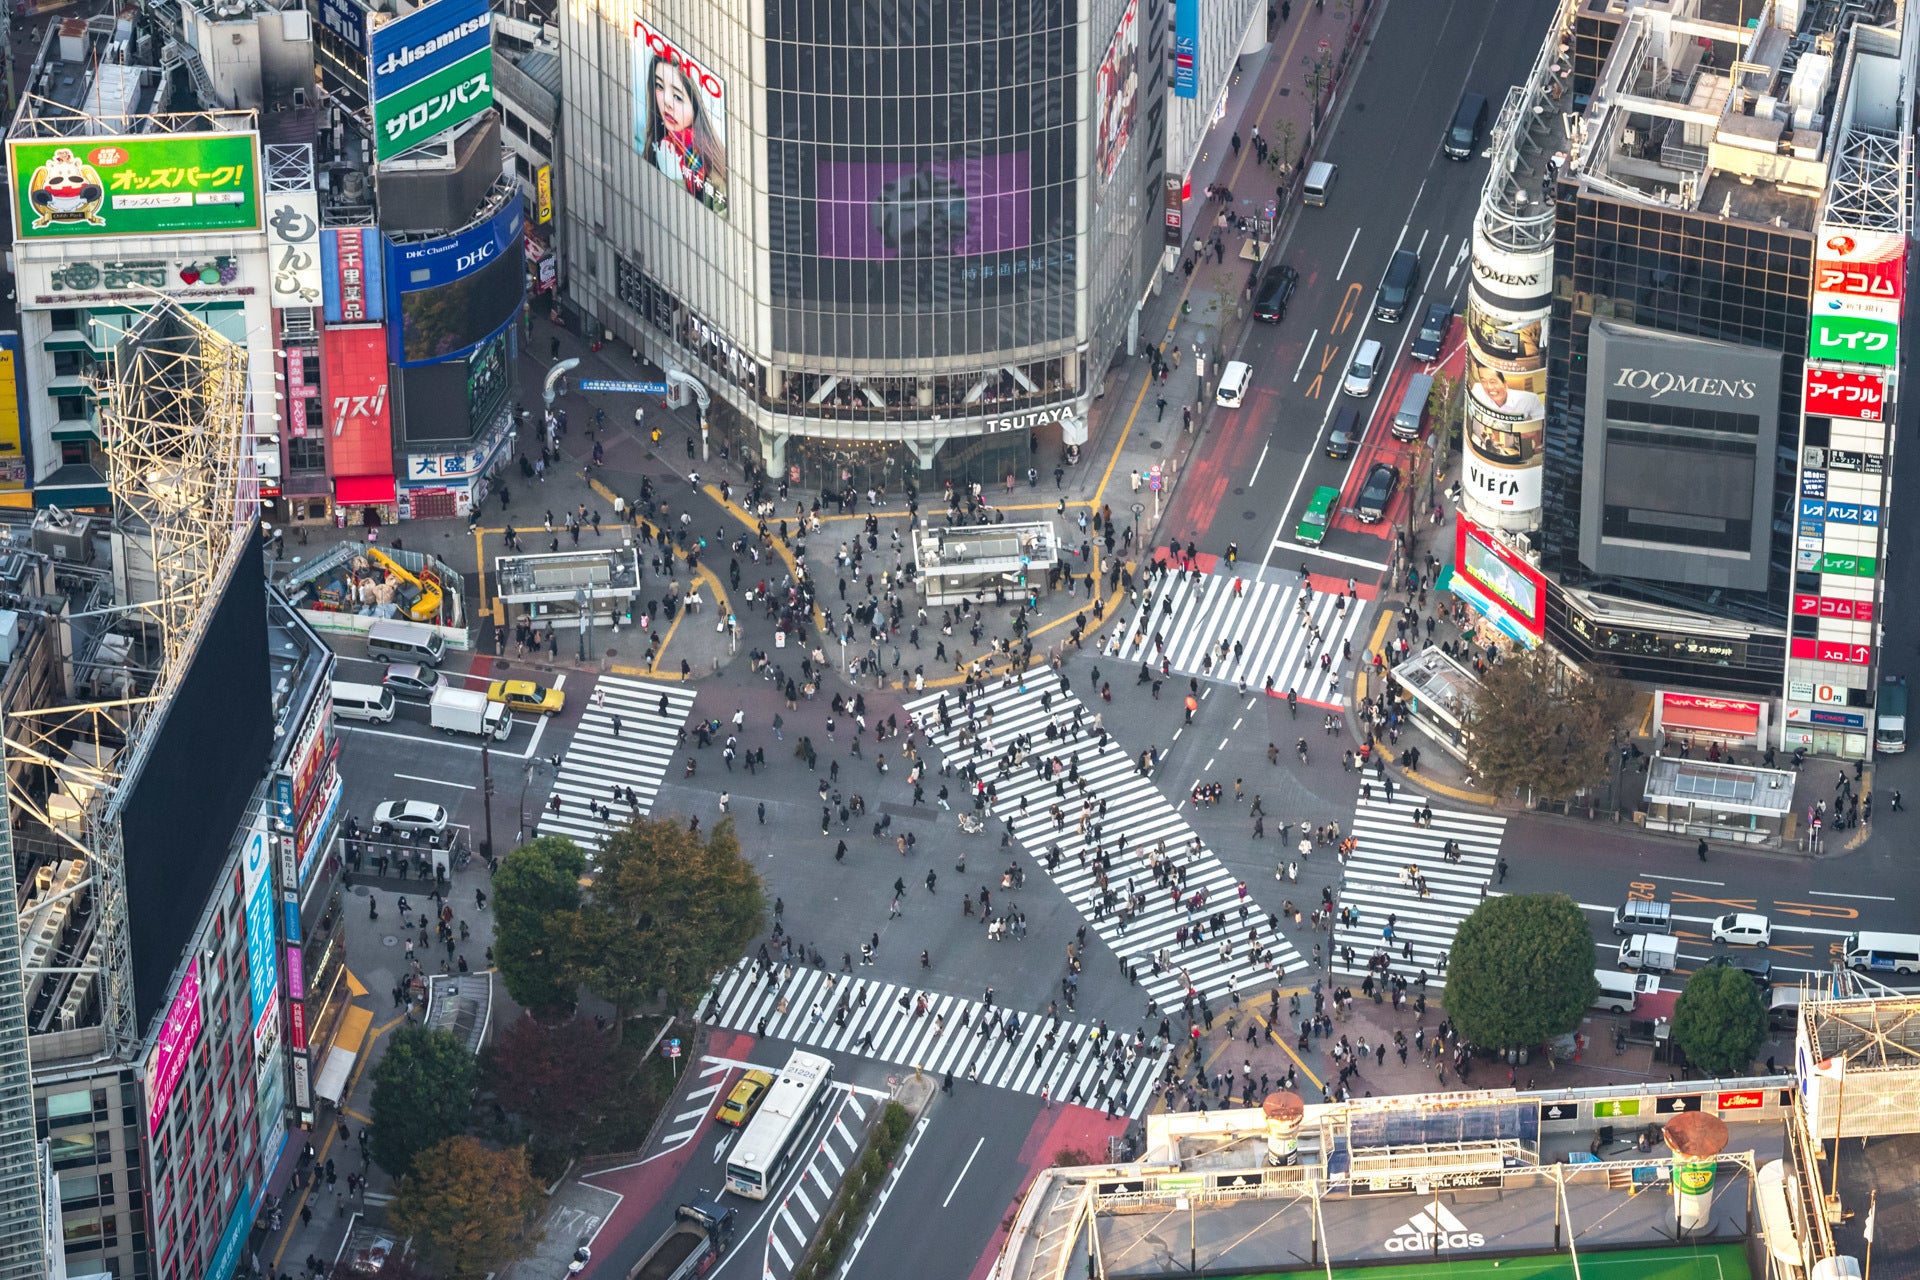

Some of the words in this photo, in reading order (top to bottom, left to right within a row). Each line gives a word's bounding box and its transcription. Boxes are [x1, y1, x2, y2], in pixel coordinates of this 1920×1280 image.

[330, 0, 358, 21] 服の
[323, 3, 360, 47] 青山
[376, 11, 490, 75] Hisamitsu
[634, 20, 722, 98] non-no
[1177, 36, 1194, 88] SEIBU
[385, 72, 490, 141] サロンパス
[110, 165, 244, 190] オッズパーク!
[118, 196, 181, 207] オッズパーク
[270, 205, 319, 303] もんじゃ
[406, 249, 425, 259] DHC
[427, 241, 459, 256] Channel
[456, 240, 494, 272] DHC
[341, 233, 363, 319] 三千里薬品
[1819, 269, 1895, 295] アコム
[691, 316, 757, 376] TSUTAYA
[1819, 327, 1889, 351] レイク
[1613, 368, 1757, 399] 109MEN'S
[1809, 382, 1881, 403] アイフル
[332, 384, 387, 437] クスリ
[986, 406, 1074, 433] TSUTAYA
[1860, 409, 1879, 419] 8F
[1470, 466, 1519, 496] VIERA
[1824, 558, 1856, 569] レイク
[1801, 599, 1851, 613] アコム
[1824, 650, 1843, 660] 入口
[1814, 713, 1846, 723] PROMISE
[284, 848, 295, 882] 献血ルーム
[262, 879, 274, 988] コンタクトの
[250, 897, 264, 1005] アイシティ
[786, 1067, 817, 1080] 21228
[1452, 1176, 1484, 1188] PARK.
[1384, 1230, 1486, 1252] adidas
